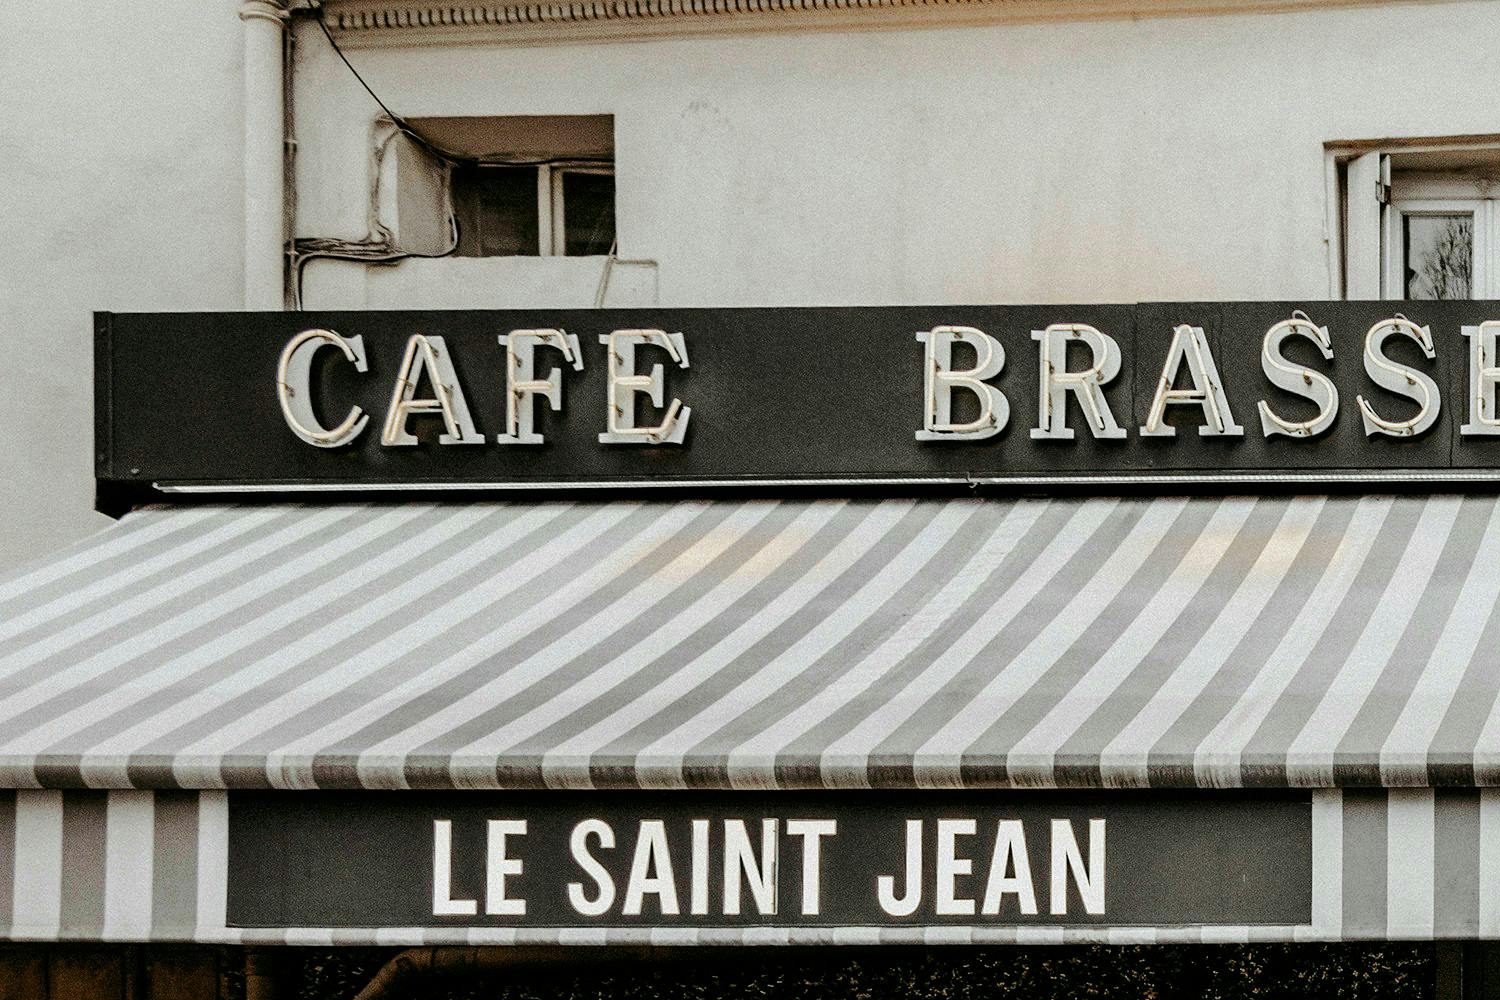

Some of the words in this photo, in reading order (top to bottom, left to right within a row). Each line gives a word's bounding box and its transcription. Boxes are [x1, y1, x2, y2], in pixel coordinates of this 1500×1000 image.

[276, 329, 691, 448] CAFE
[433, 819, 527, 915] LE
[567, 818, 838, 916] SAINT
[877, 818, 1106, 916] JEAN
